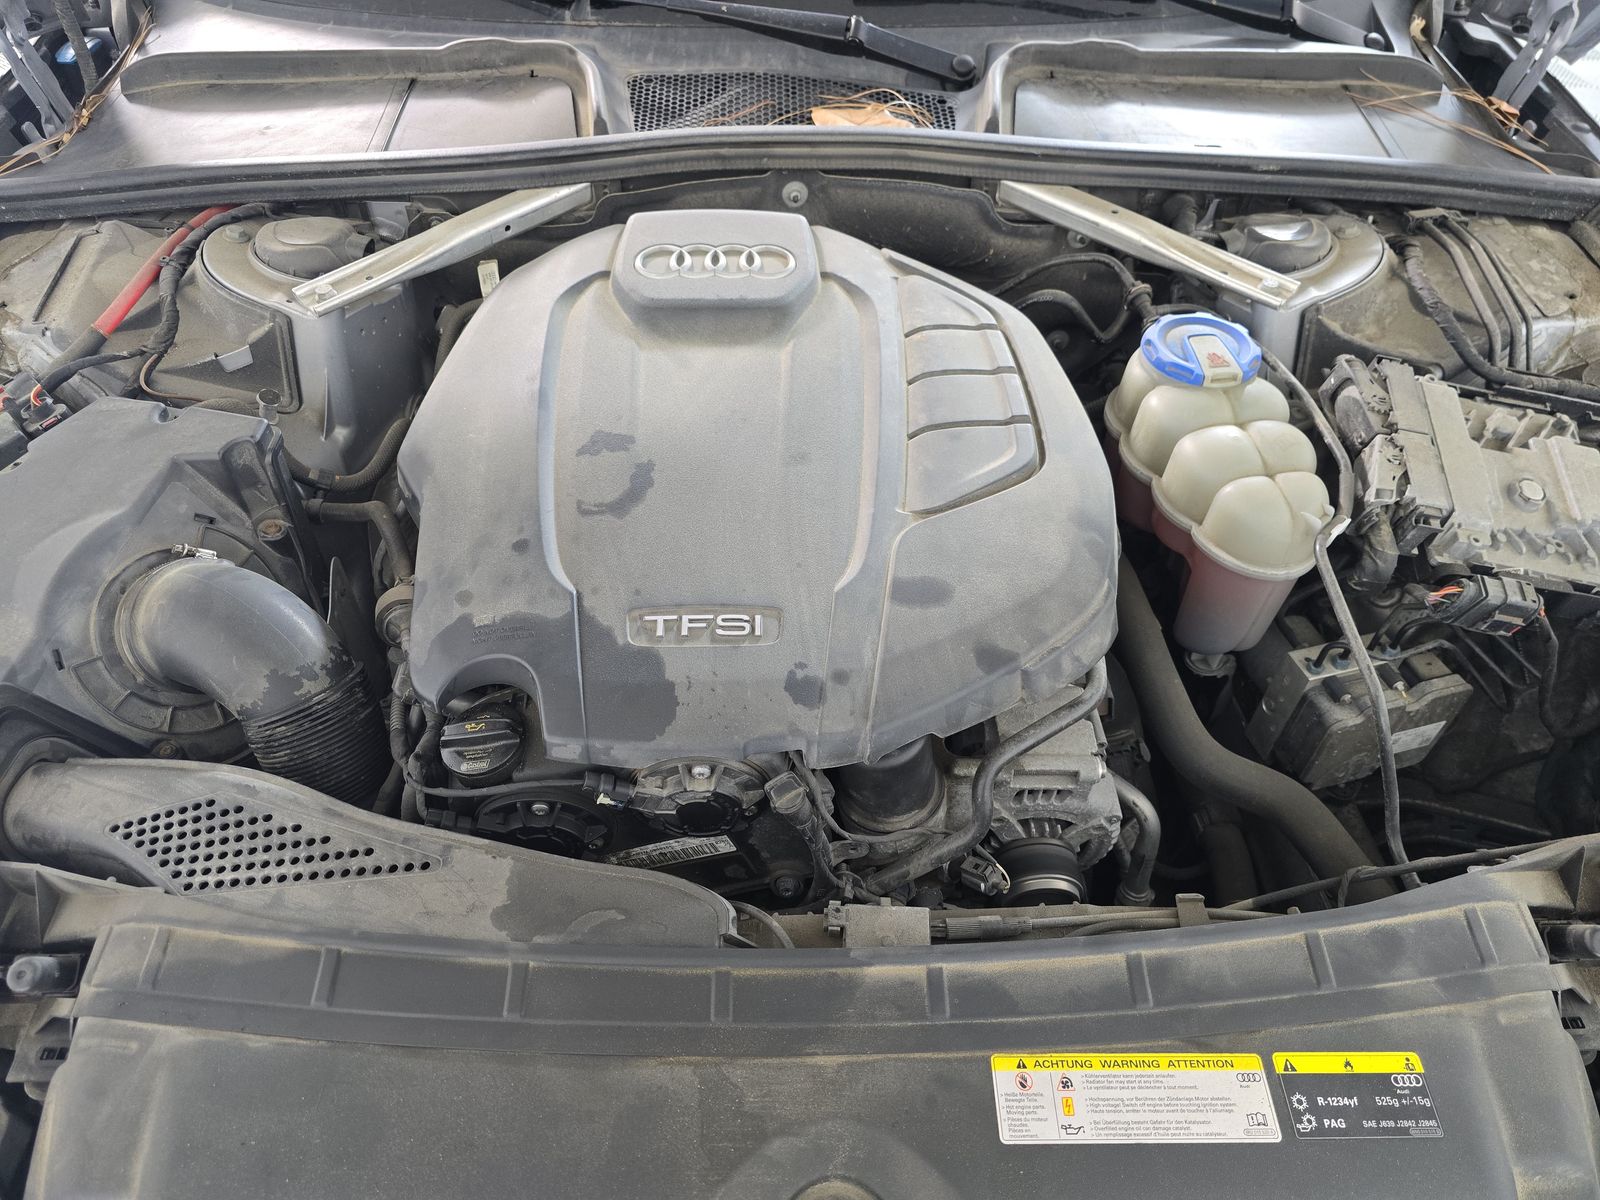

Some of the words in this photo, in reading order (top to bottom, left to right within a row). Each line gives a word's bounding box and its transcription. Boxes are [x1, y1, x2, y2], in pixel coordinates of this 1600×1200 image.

[643, 614, 762, 637] TFSI
[1034, 1059, 1093, 1069] ACHTUNG
[1100, 1059, 1160, 1069] WARNING
[1167, 1059, 1234, 1069] ATTENTION
[1316, 1096, 1358, 1107] R-1234yf
[1375, 1096, 1399, 1107] 525g
[1401, 1096, 1431, 1107] +/-15g
[1324, 1119, 1346, 1128] PAG
